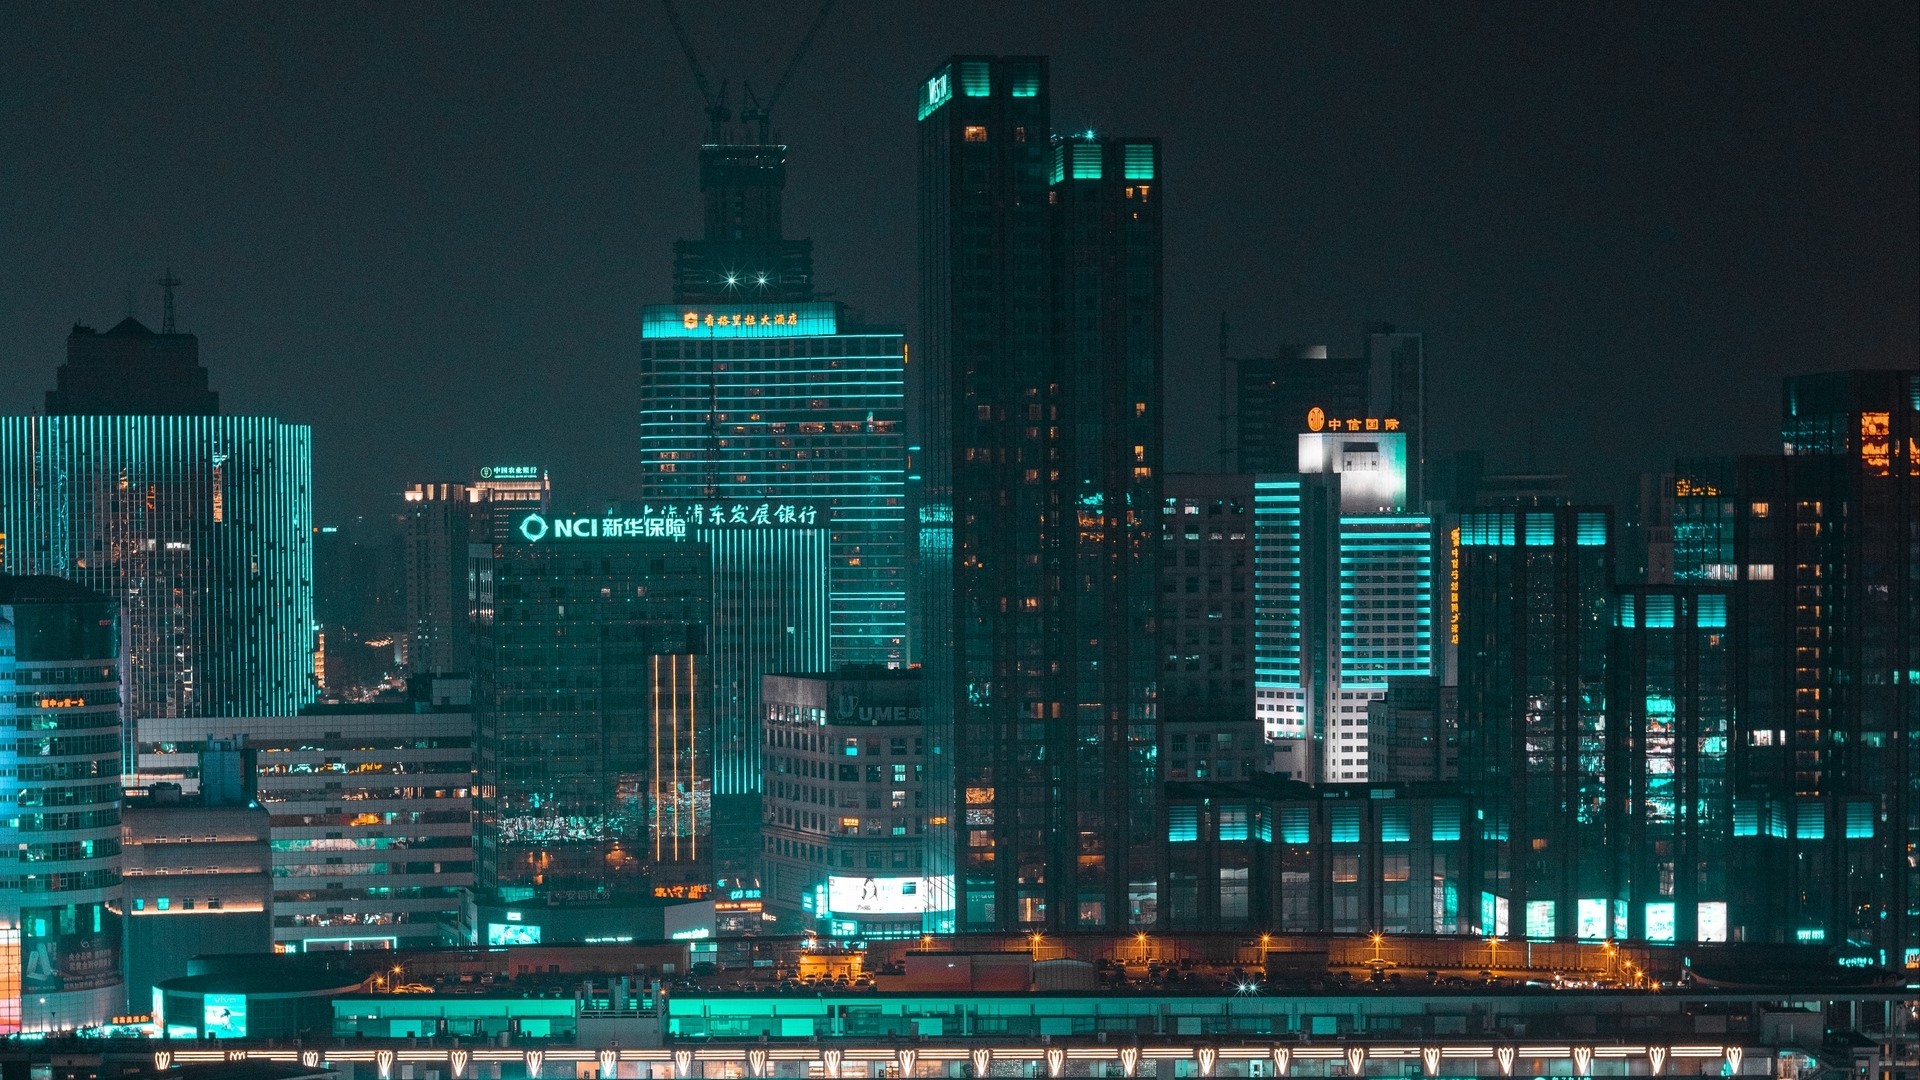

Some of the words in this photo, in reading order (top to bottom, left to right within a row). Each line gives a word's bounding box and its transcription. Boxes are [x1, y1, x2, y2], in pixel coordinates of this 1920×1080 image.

[1328, 418, 1400, 431] 中信国际
[493, 466, 537, 474] 中国农业银行
[554, 519, 597, 537] NCI
[602, 517, 686, 538] 新华保险
[858, 706, 907, 721] UME
[213, 996, 237, 1004] vivo
